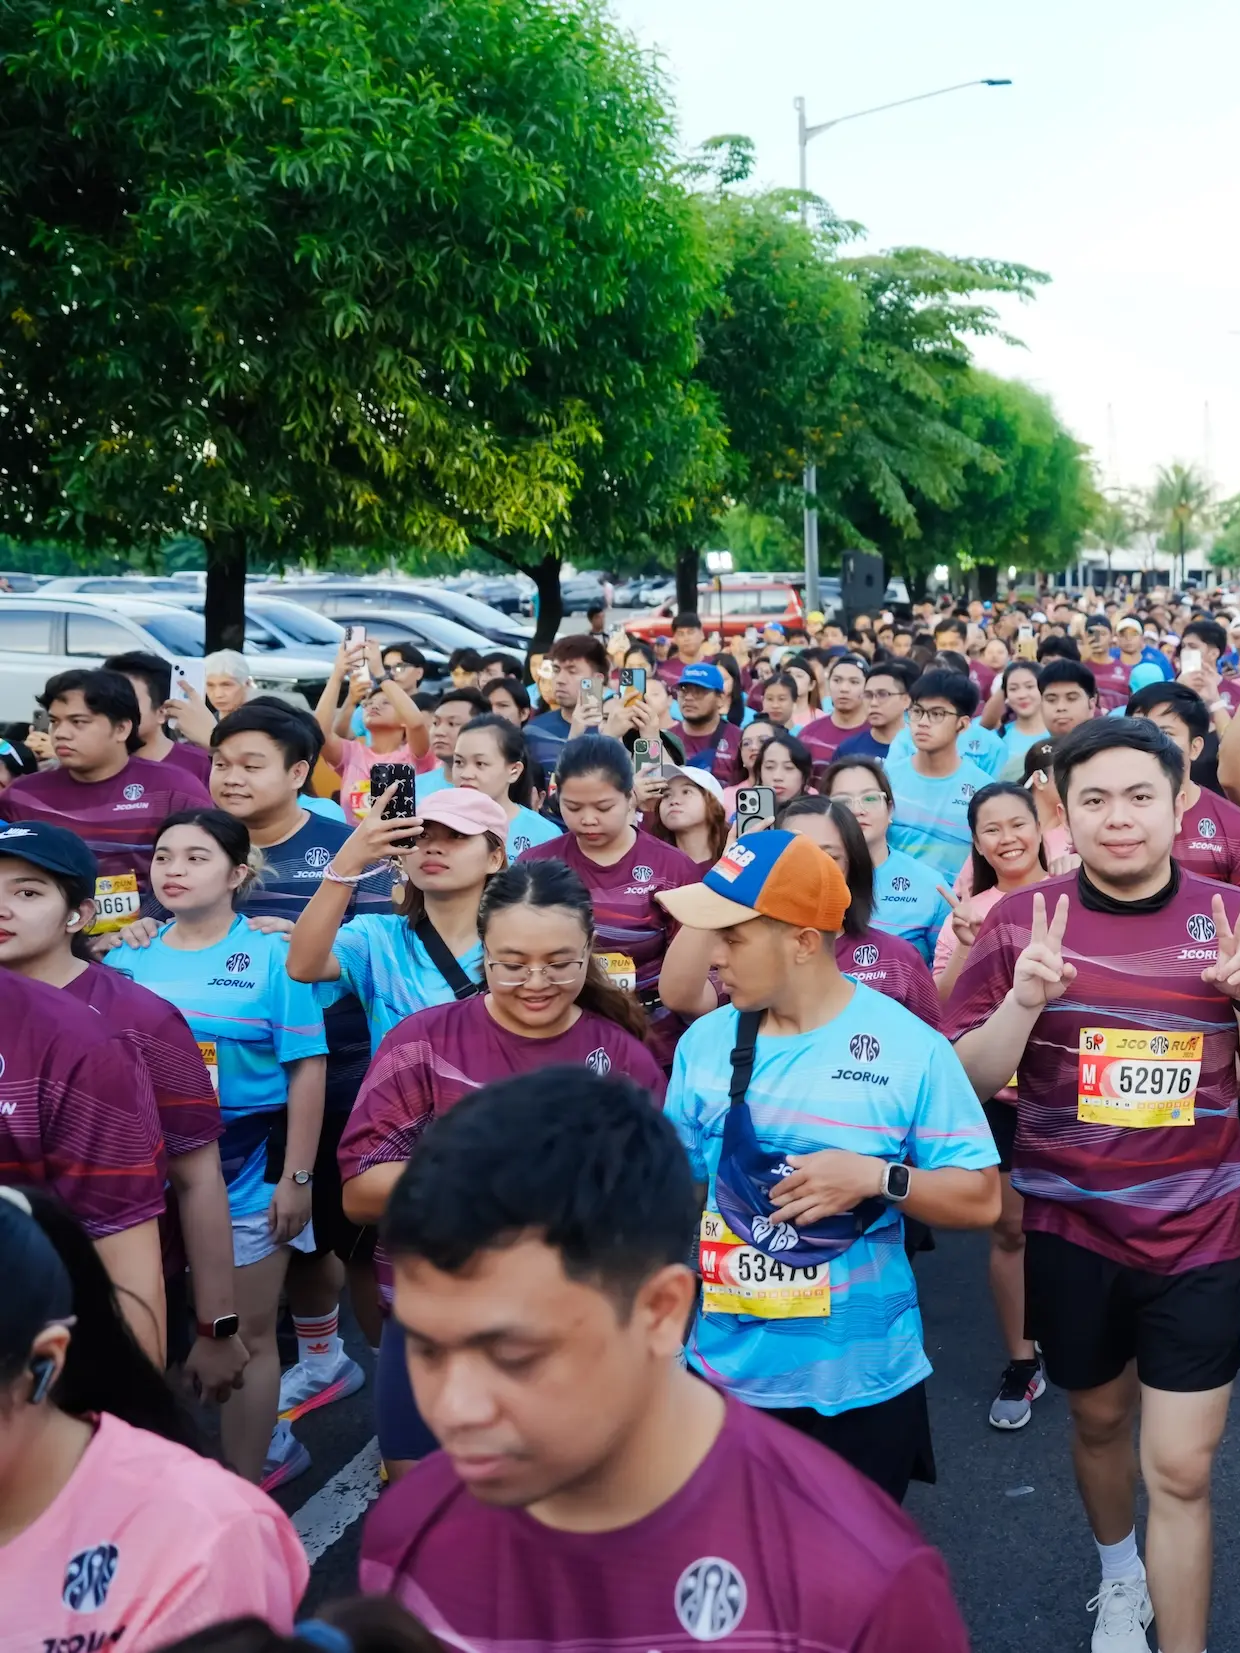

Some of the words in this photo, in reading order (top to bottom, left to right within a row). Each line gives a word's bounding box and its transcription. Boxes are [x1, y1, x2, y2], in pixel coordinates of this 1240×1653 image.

[1188, 842, 1223, 852] JCORUN
[292, 870, 325, 879] JCOR
[94, 896, 133, 915] 0661
[881, 895, 918, 903] JCORUN
[610, 959, 630, 968] RUN
[849, 971, 887, 981] CORUN
[207, 978, 256, 989] JCORUN
[1115, 1038, 1147, 1050] JCO
[1171, 1040, 1197, 1051] RUN
[831, 1069, 890, 1087] JCORUN
[1082, 1063, 1097, 1084] M
[1119, 1066, 1192, 1094] 52976
[705, 1221, 719, 1237] 5K
[702, 1250, 717, 1272] M
